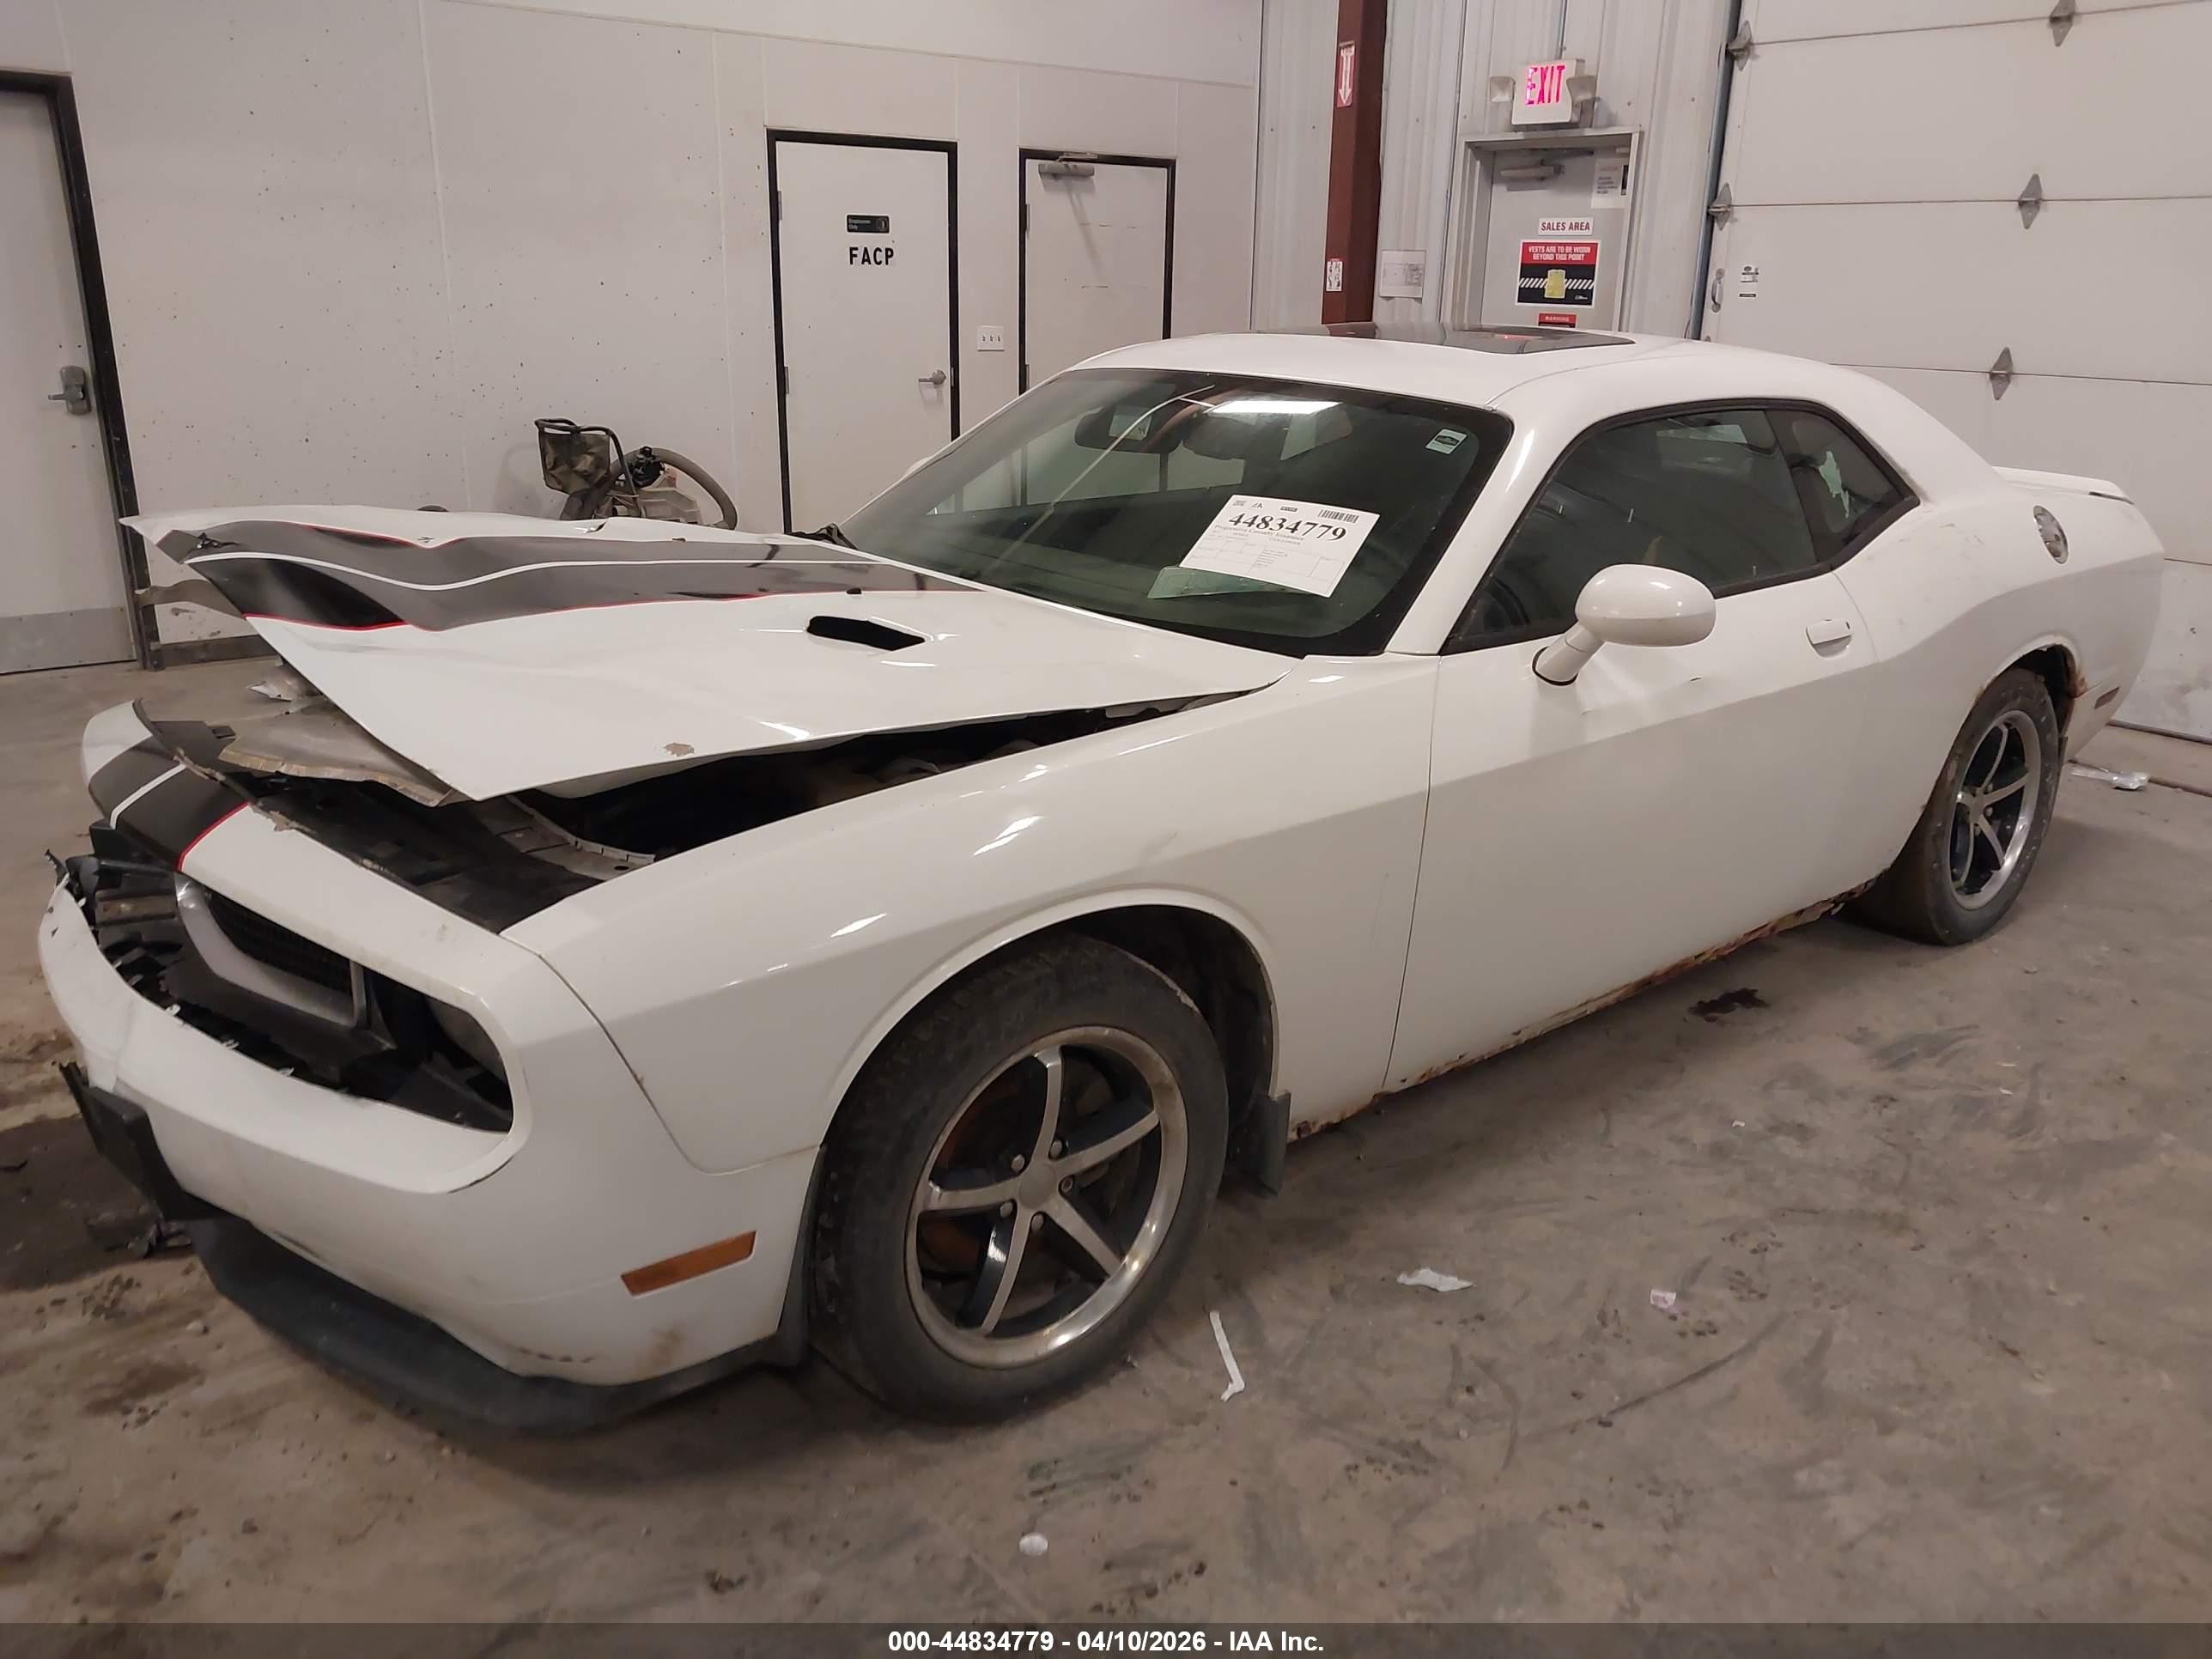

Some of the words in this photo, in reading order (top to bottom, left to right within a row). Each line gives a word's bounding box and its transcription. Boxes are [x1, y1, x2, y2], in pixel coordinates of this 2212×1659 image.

[1525, 65, 1566, 105] EXIT
[1540, 222, 1566, 231] SALES
[1568, 222, 1590, 231] AREA
[849, 246, 894, 265] FACP
[1229, 513, 1346, 541] 44834779
